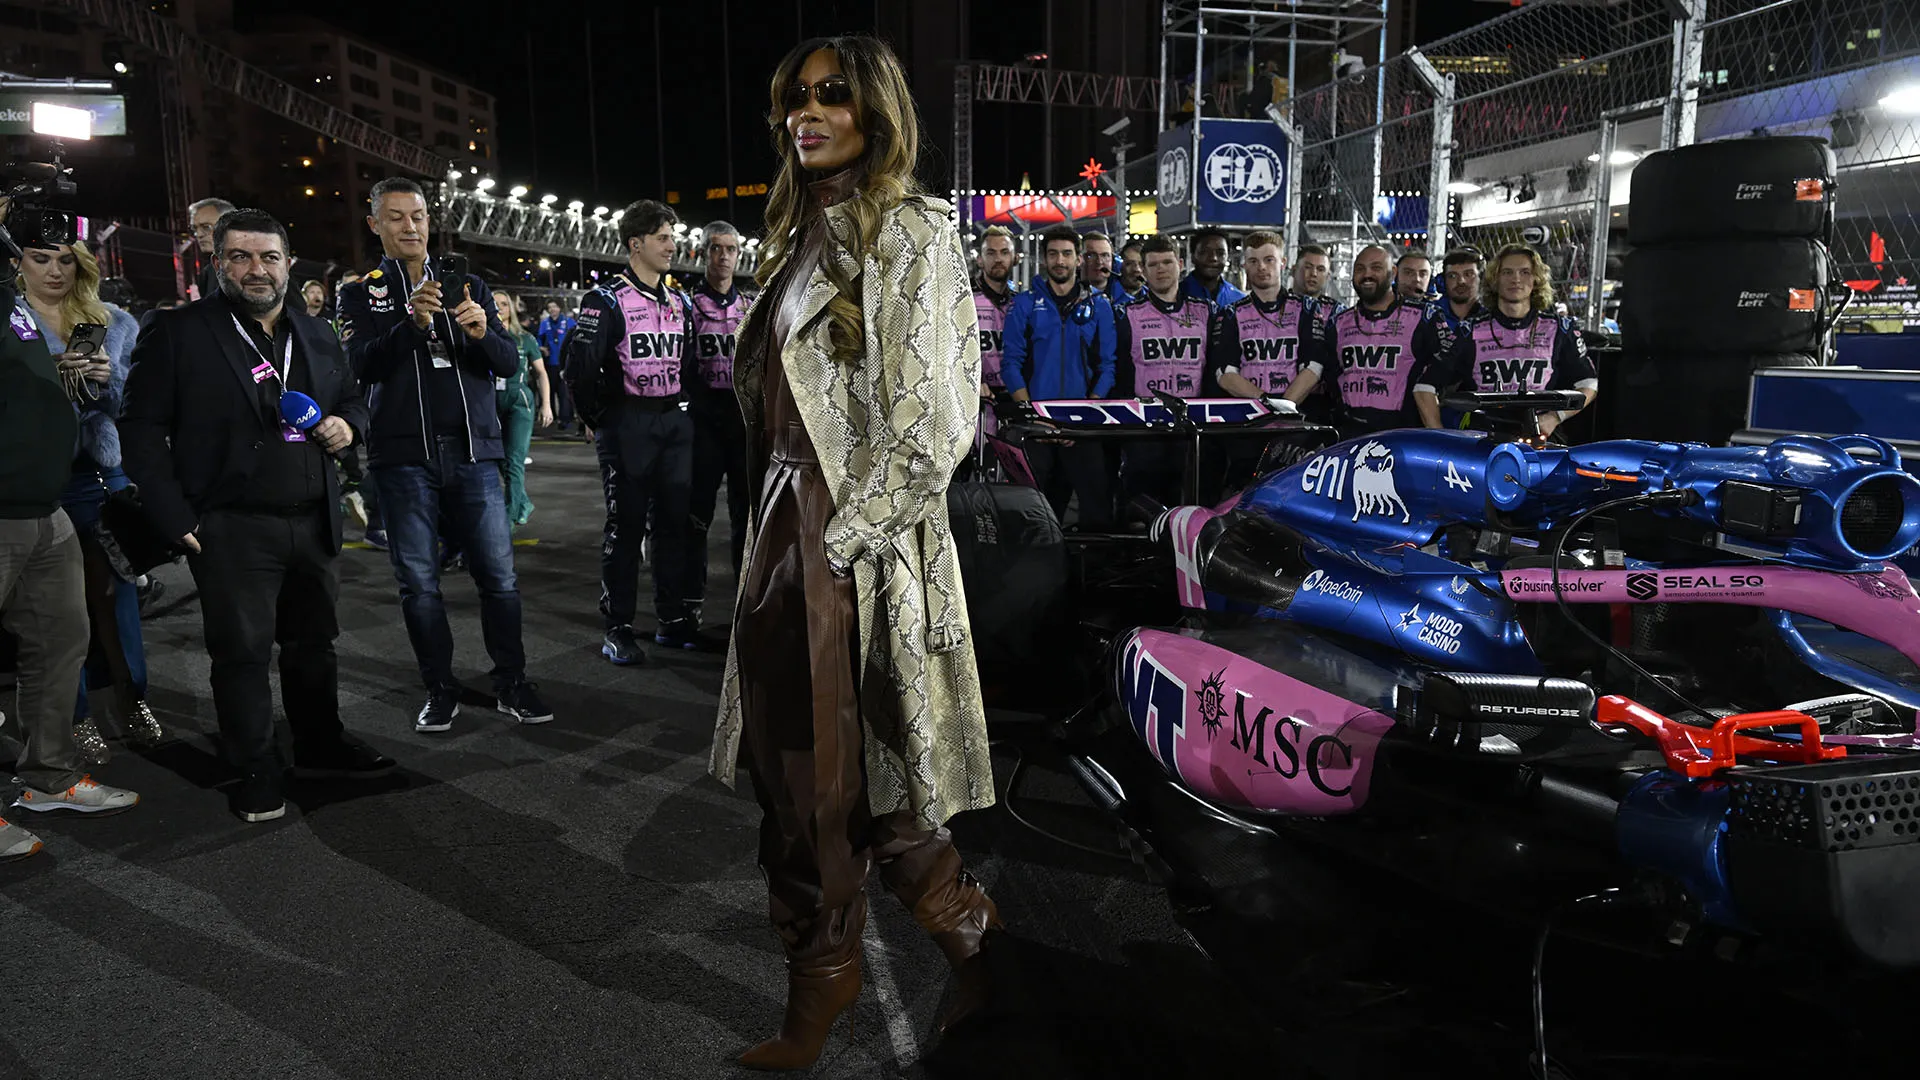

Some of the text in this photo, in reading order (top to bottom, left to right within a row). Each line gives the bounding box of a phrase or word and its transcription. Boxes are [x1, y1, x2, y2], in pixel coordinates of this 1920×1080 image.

[1735, 191, 1764, 200] Left
[1737, 183, 1773, 192] Front
[1736, 299, 1764, 308] Left
[1739, 290, 1770, 299] Rear
[629, 333, 684, 360] BWT
[698, 333, 735, 359] BW
[1142, 336, 1202, 361] BWT
[1241, 337, 1299, 361] BWT
[1341, 344, 1403, 370] BWT
[637, 371, 666, 387] eni
[1147, 375, 1173, 390] eni
[1480, 359, 1548, 385] BWT
[1342, 377, 1365, 392] eni
[1301, 444, 1359, 501] eni
[1315, 575, 1364, 604] ApeCoin
[1663, 575, 1764, 588] SEAL SQ
[1664, 590, 1724, 598] semiconductors
[1731, 591, 1765, 599] quantum
[1424, 611, 1464, 637] MODO
[1417, 626, 1461, 655] CASINO
[1231, 691, 1353, 797] MSC
